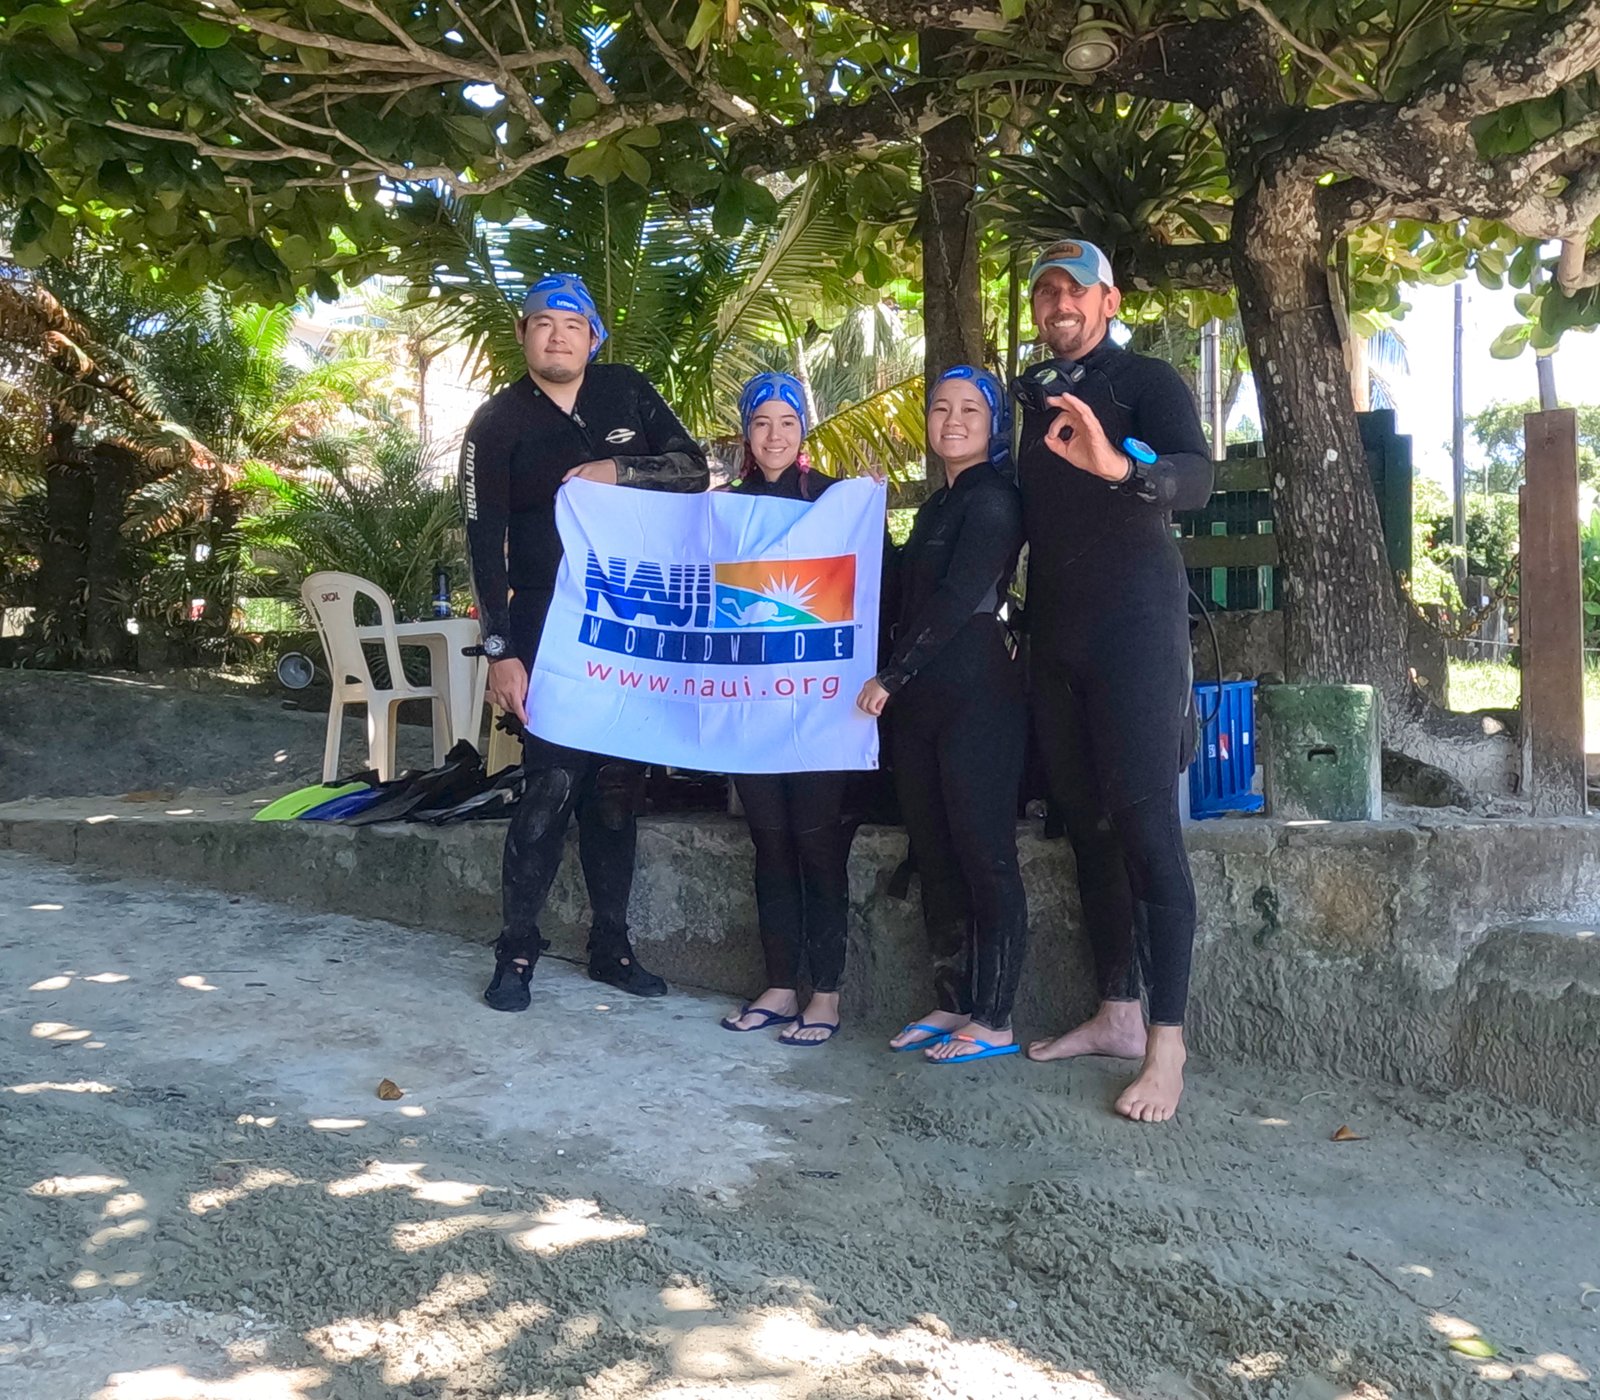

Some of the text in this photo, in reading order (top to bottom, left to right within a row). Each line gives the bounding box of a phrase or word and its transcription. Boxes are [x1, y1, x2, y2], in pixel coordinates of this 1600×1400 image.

[465, 442, 478, 520] mormaii
[585, 549, 710, 628] NAUI
[588, 618, 844, 662] WORLDWIDE
[587, 660, 840, 700] www.naui.org
